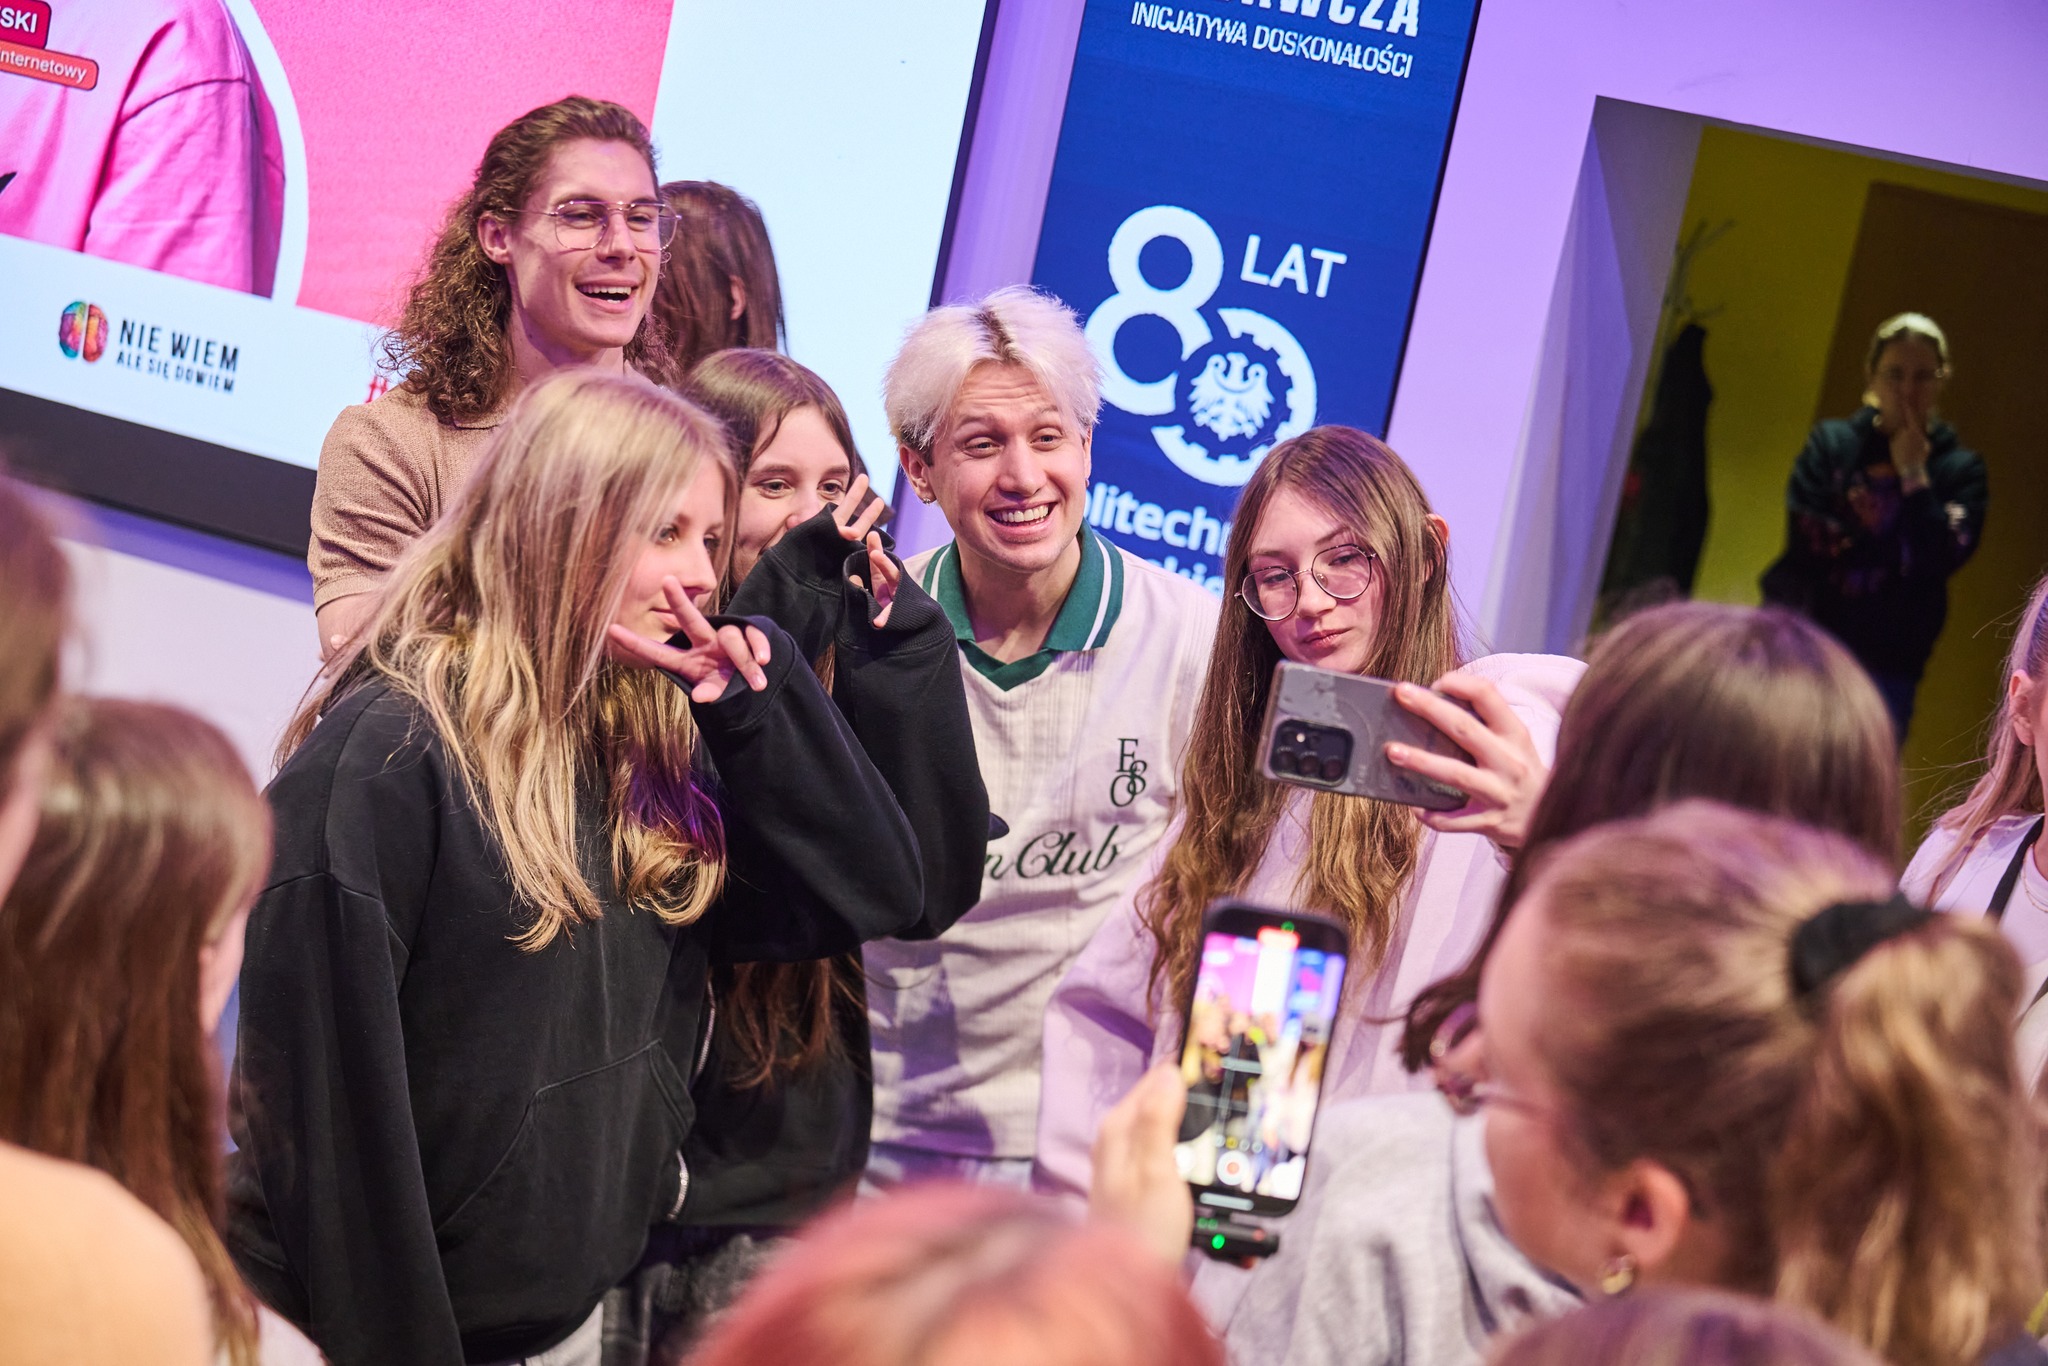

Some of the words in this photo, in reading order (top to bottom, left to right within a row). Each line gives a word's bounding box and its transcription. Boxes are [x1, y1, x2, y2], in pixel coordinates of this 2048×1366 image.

[0, 6, 38, 33] SKI
[1131, 1, 1248, 46] INICJATYWA
[1252, 25, 1414, 79] DOSKONAŁOŚCI
[0, 48, 87, 83] nternetowy
[1240, 234, 1347, 298] LAT
[119, 319, 162, 353] NIE
[171, 331, 239, 372] WIEM
[1084, 482, 1233, 558] litech
[1016, 825, 1119, 880] Club
